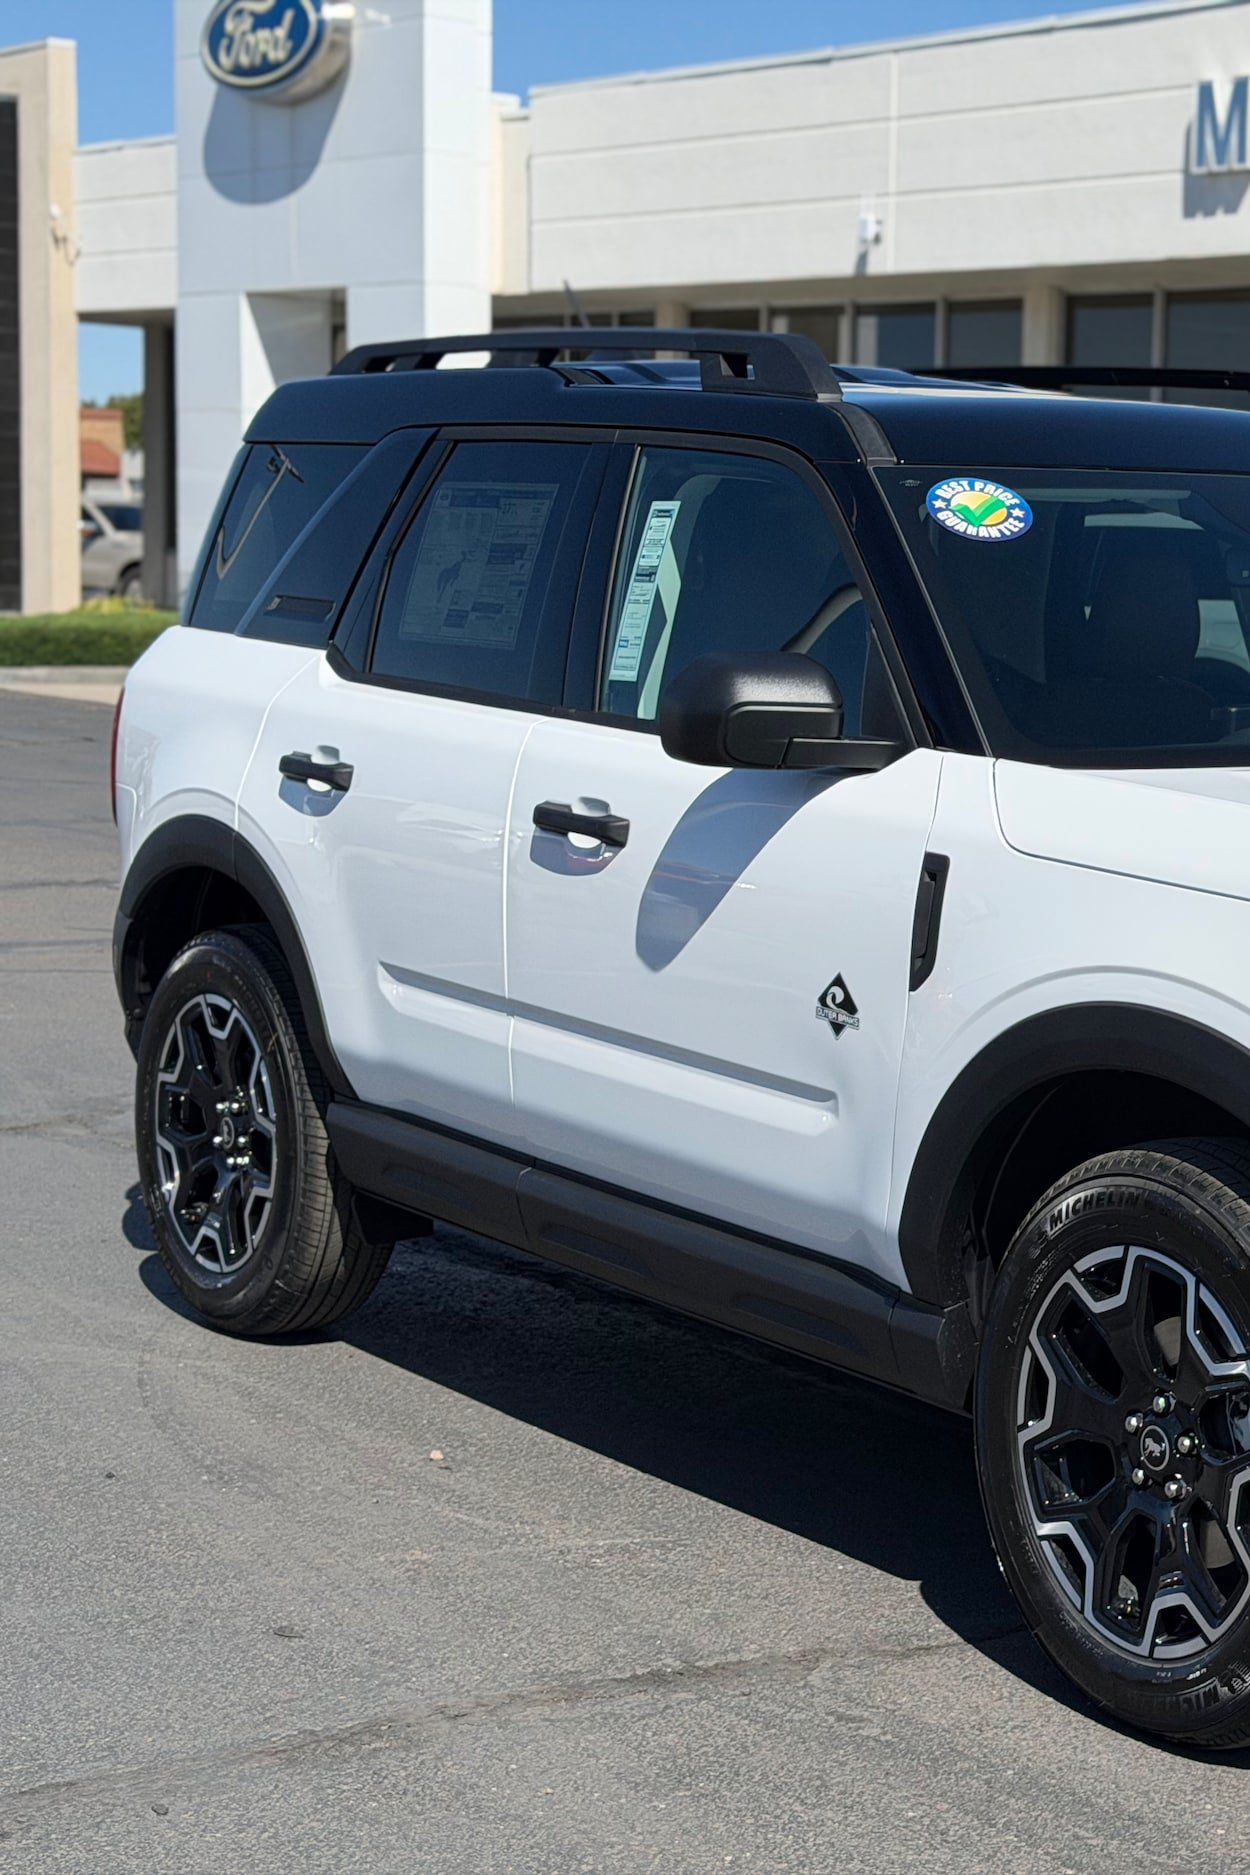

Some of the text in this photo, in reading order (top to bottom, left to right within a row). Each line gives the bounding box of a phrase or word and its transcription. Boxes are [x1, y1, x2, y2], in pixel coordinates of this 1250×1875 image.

[218, 0, 295, 71] Ford
[935, 480, 1020, 507] BEST PRICE
[936, 510, 1025, 538] GUARANTEE
[817, 1007, 859, 1026] OUTER BANKS
[1048, 1188, 1143, 1232] MICHELIN
